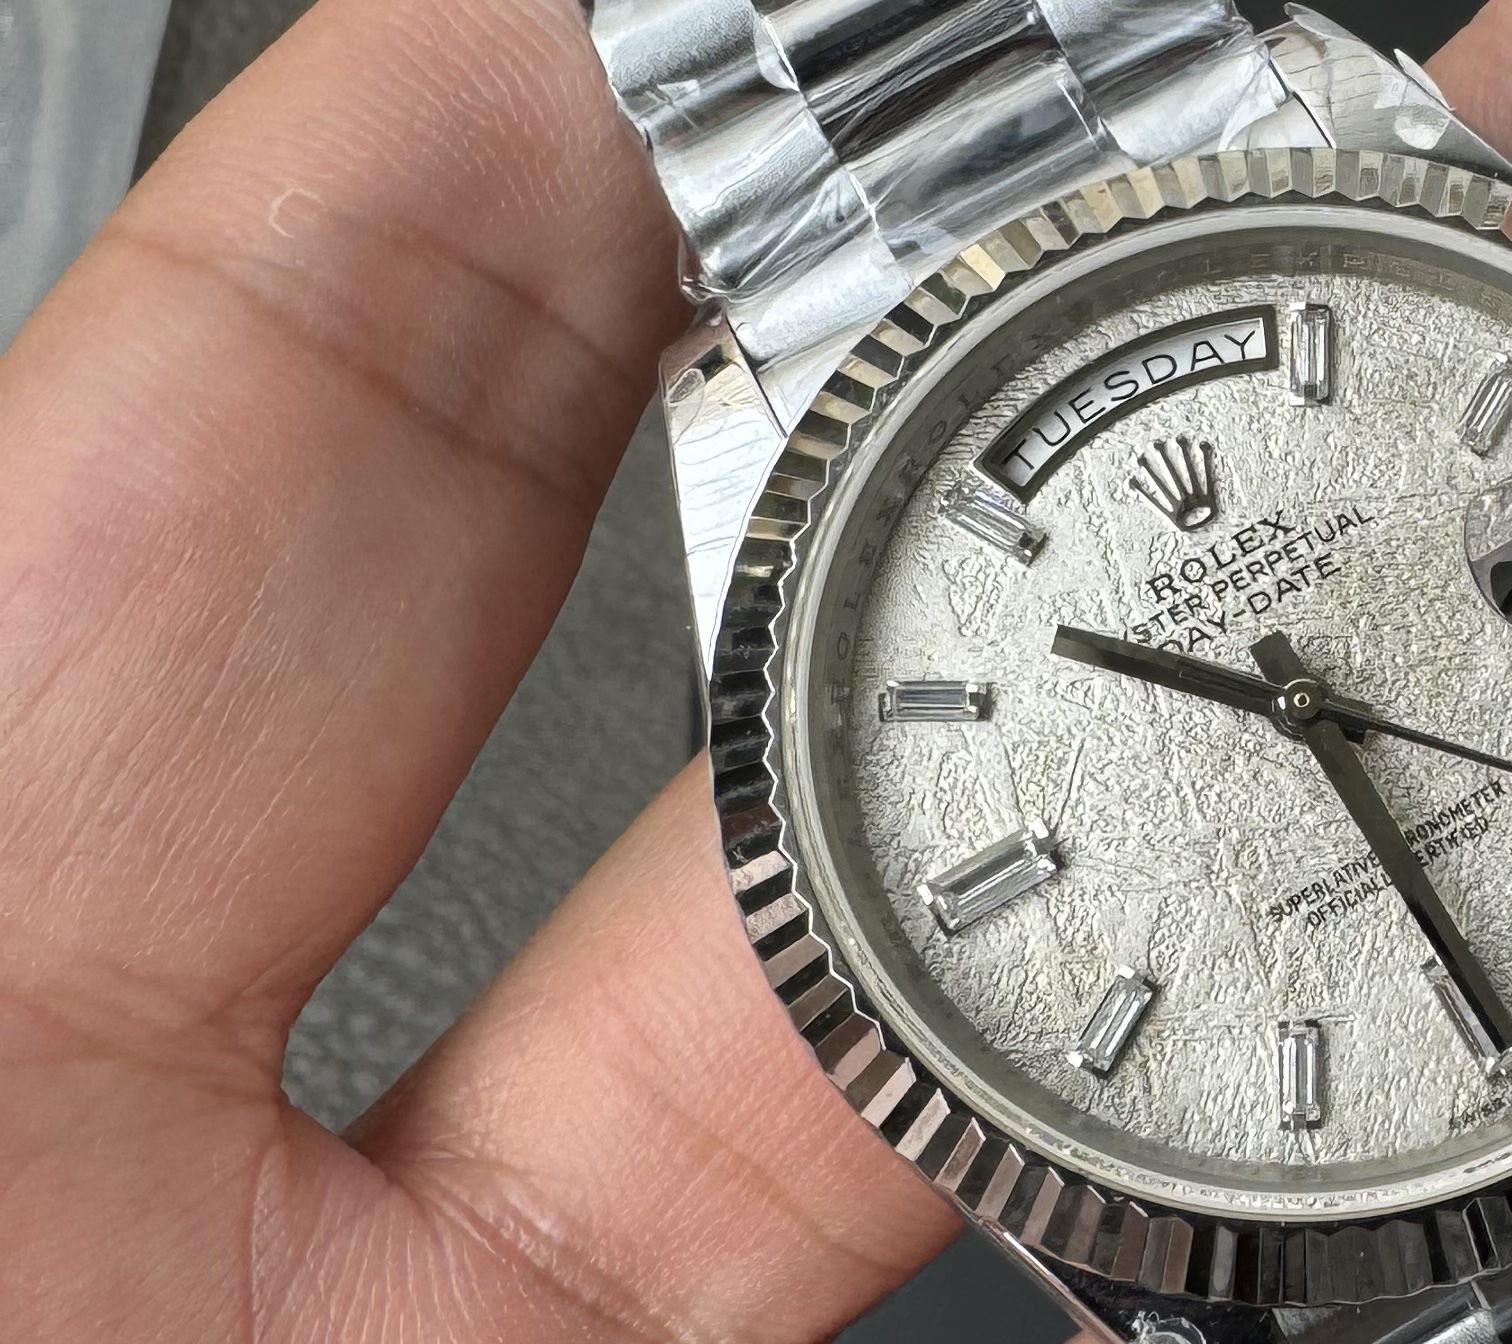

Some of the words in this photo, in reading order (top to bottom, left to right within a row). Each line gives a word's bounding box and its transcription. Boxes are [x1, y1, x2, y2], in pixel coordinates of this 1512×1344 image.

[1001, 329, 1256, 470] TUESDAY
[1122, 593, 1211, 645] STER
[1210, 507, 1376, 602] PERPETUAL
[1148, 509, 1297, 604] ROLEX
[1268, 850, 1382, 923] SUPERLATIVE
[1402, 779, 1507, 848] RONOMETER
[1306, 871, 1393, 928] OFFICIALL
[1413, 817, 1490, 868] ERTIFIED
